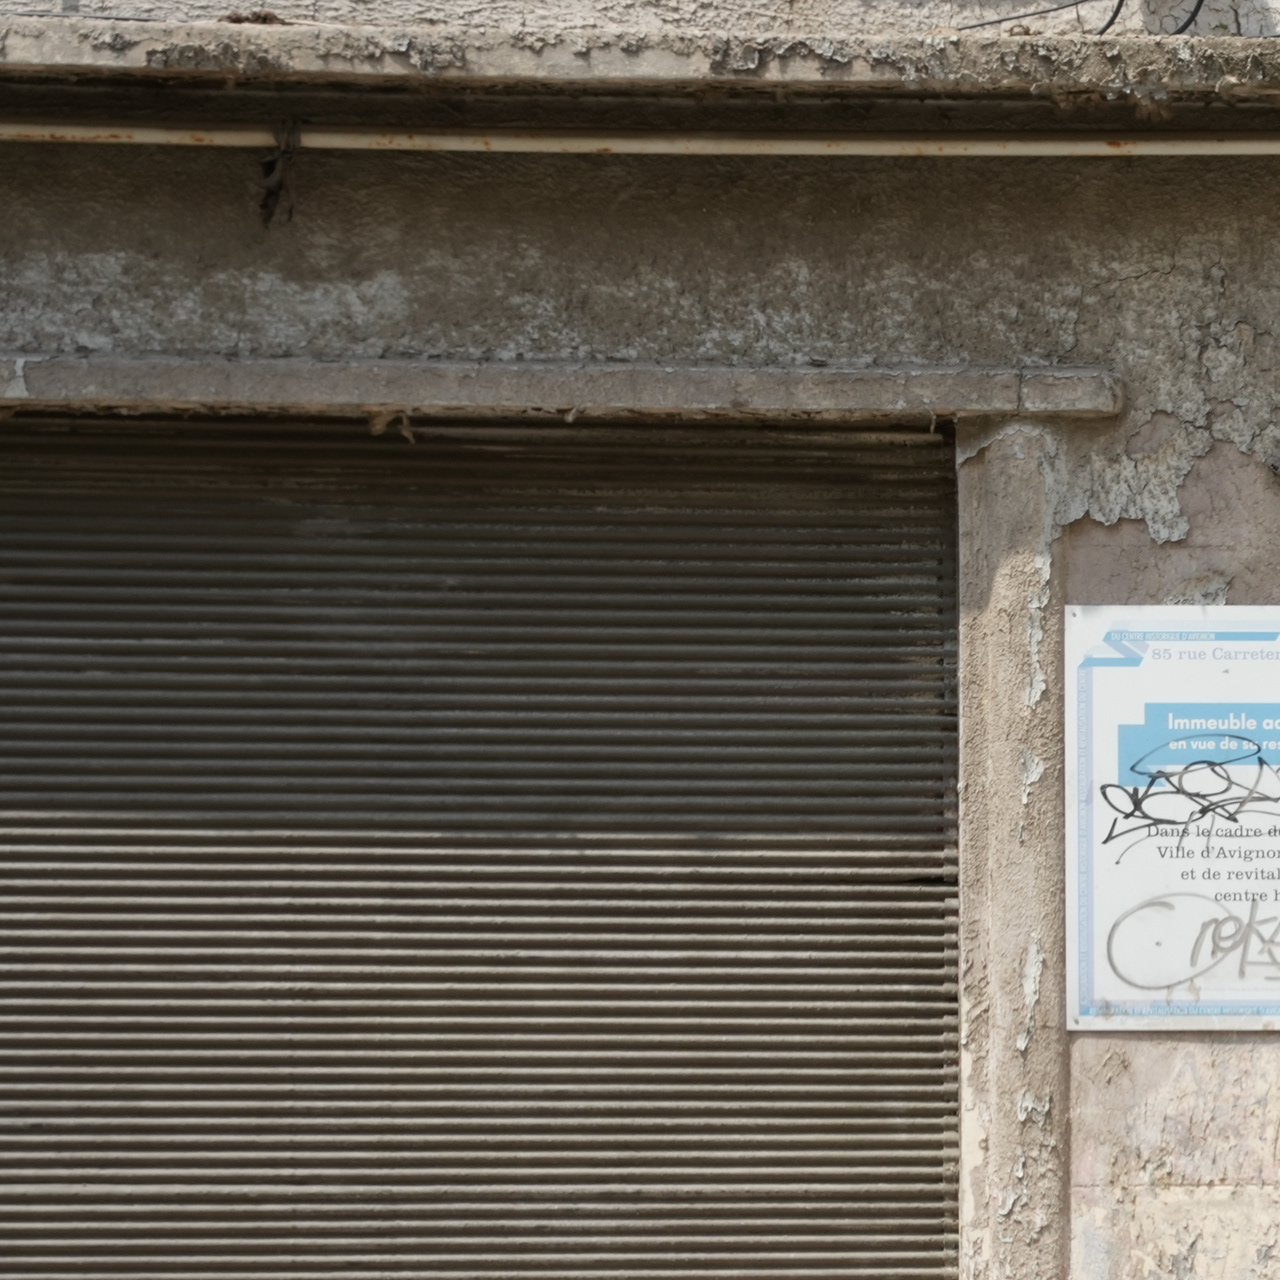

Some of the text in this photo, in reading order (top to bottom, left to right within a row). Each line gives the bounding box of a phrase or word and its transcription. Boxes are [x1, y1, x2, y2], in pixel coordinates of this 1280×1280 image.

[1151, 647, 1172, 661] 85
[1178, 650, 1207, 661] rue
[1168, 712, 1258, 731] Immeuble
[1168, 739, 1187, 750] en
[1190, 739, 1215, 750] vue
[1219, 736, 1238, 750] de
[1147, 824, 1190, 838] Dans
[1195, 824, 1210, 838] le
[1215, 824, 1263, 838] cadre
[1180, 868, 1197, 881] et
[1201, 866, 1221, 881] de
[1213, 890, 1269, 902] centre
